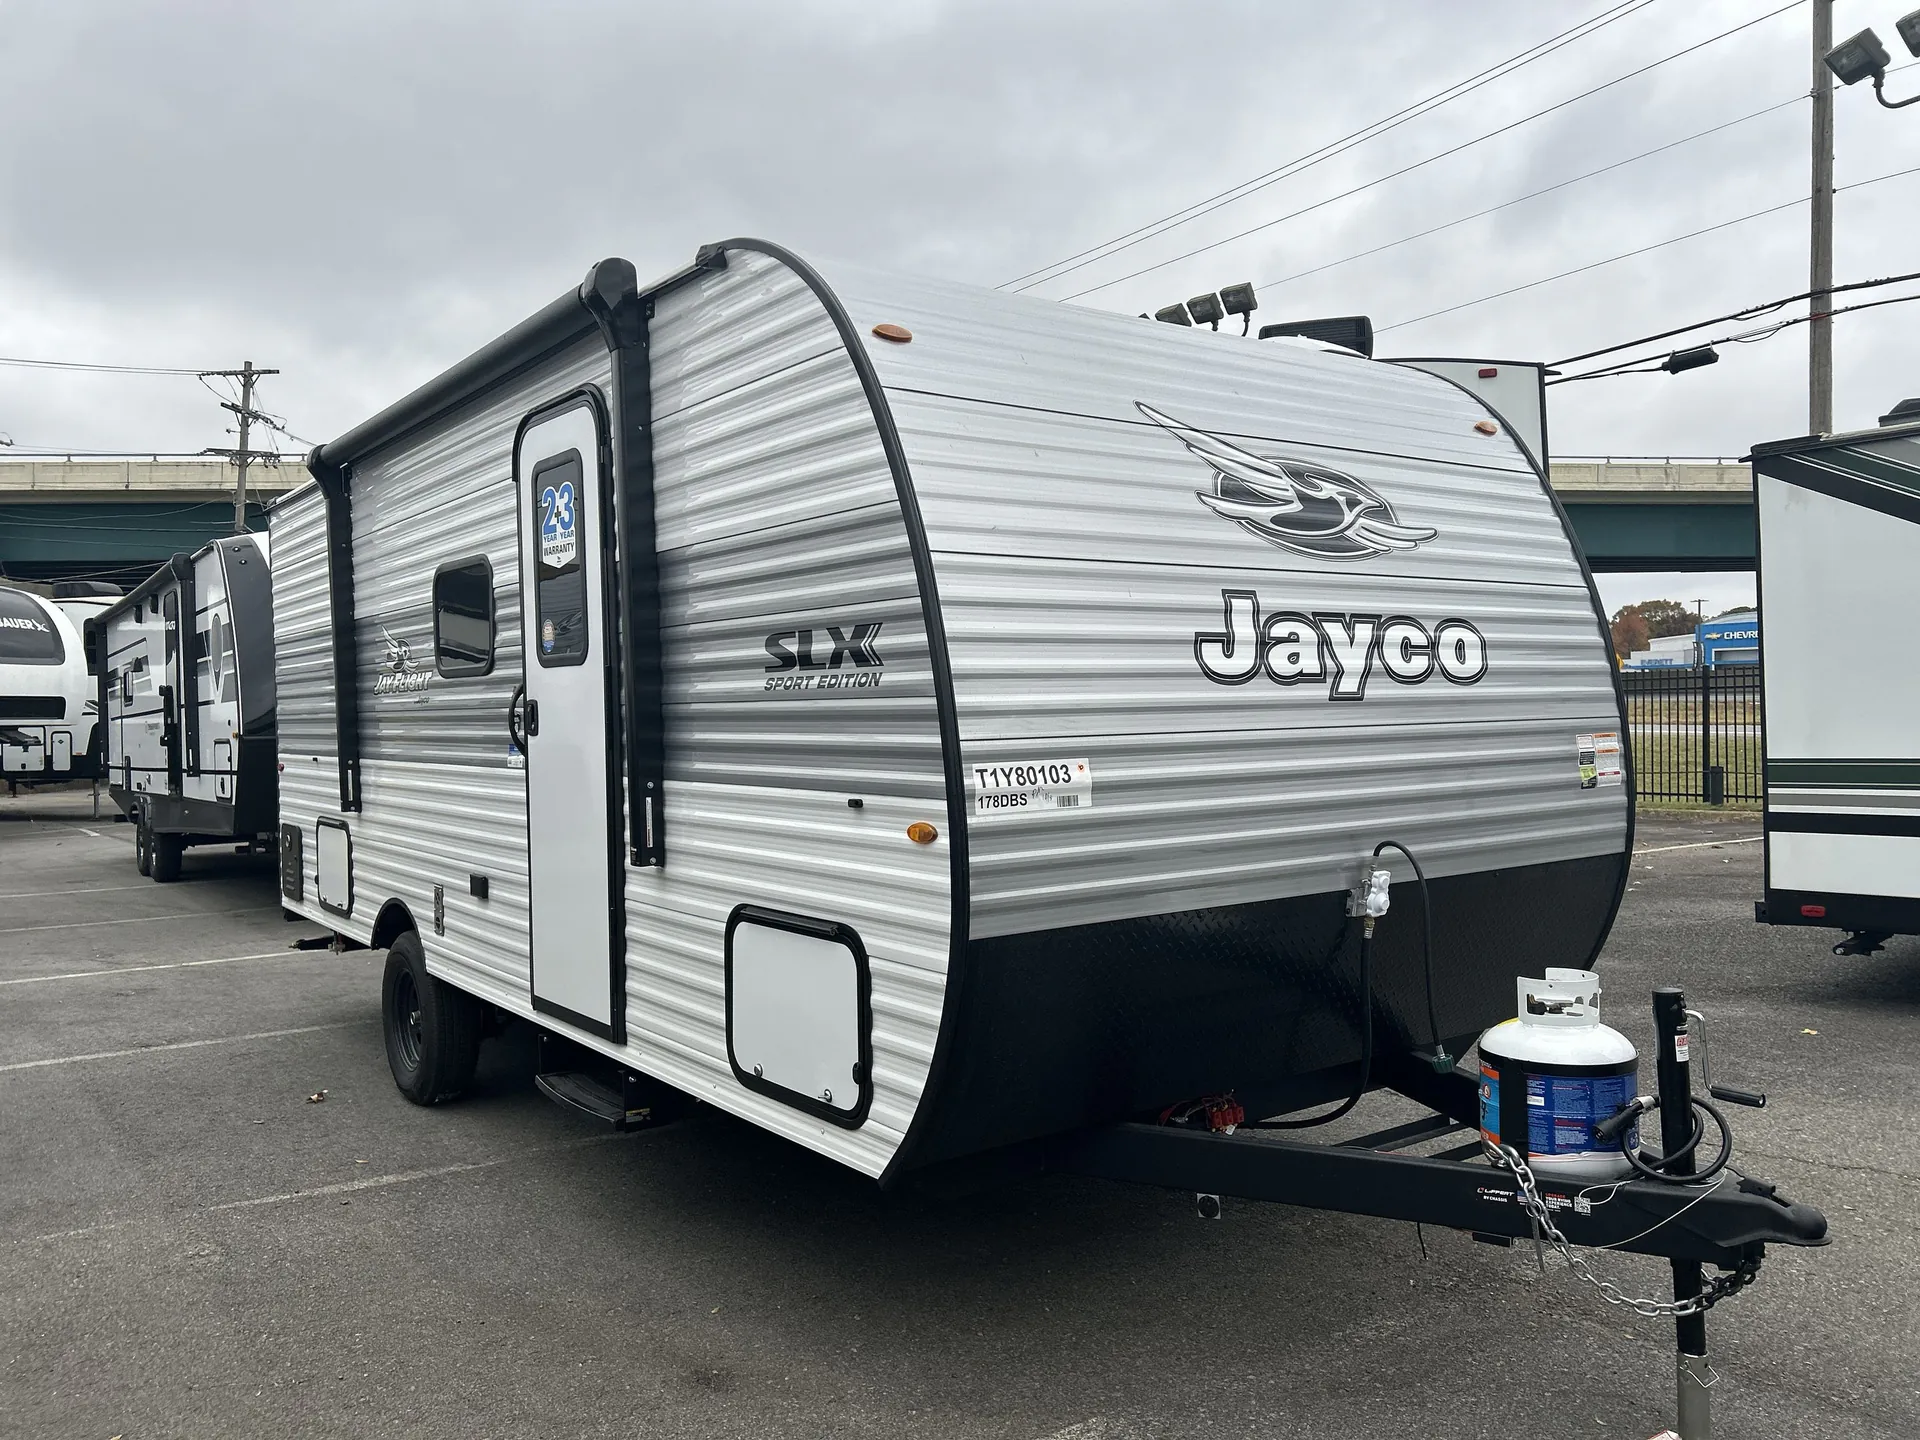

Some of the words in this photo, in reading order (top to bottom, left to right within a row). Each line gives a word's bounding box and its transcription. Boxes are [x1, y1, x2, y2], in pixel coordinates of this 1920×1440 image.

[543, 534, 558, 542] YEAR
[560, 530, 574, 539] YEAR
[544, 542, 575, 556] WARRANTY
[765, 622, 884, 673] SLX
[1194, 589, 1488, 701] Jayco
[764, 676, 815, 691] SPORT
[816, 672, 883, 689] EDITION
[975, 764, 1072, 788] T1Y80103
[978, 793, 1028, 809] 178DBS
